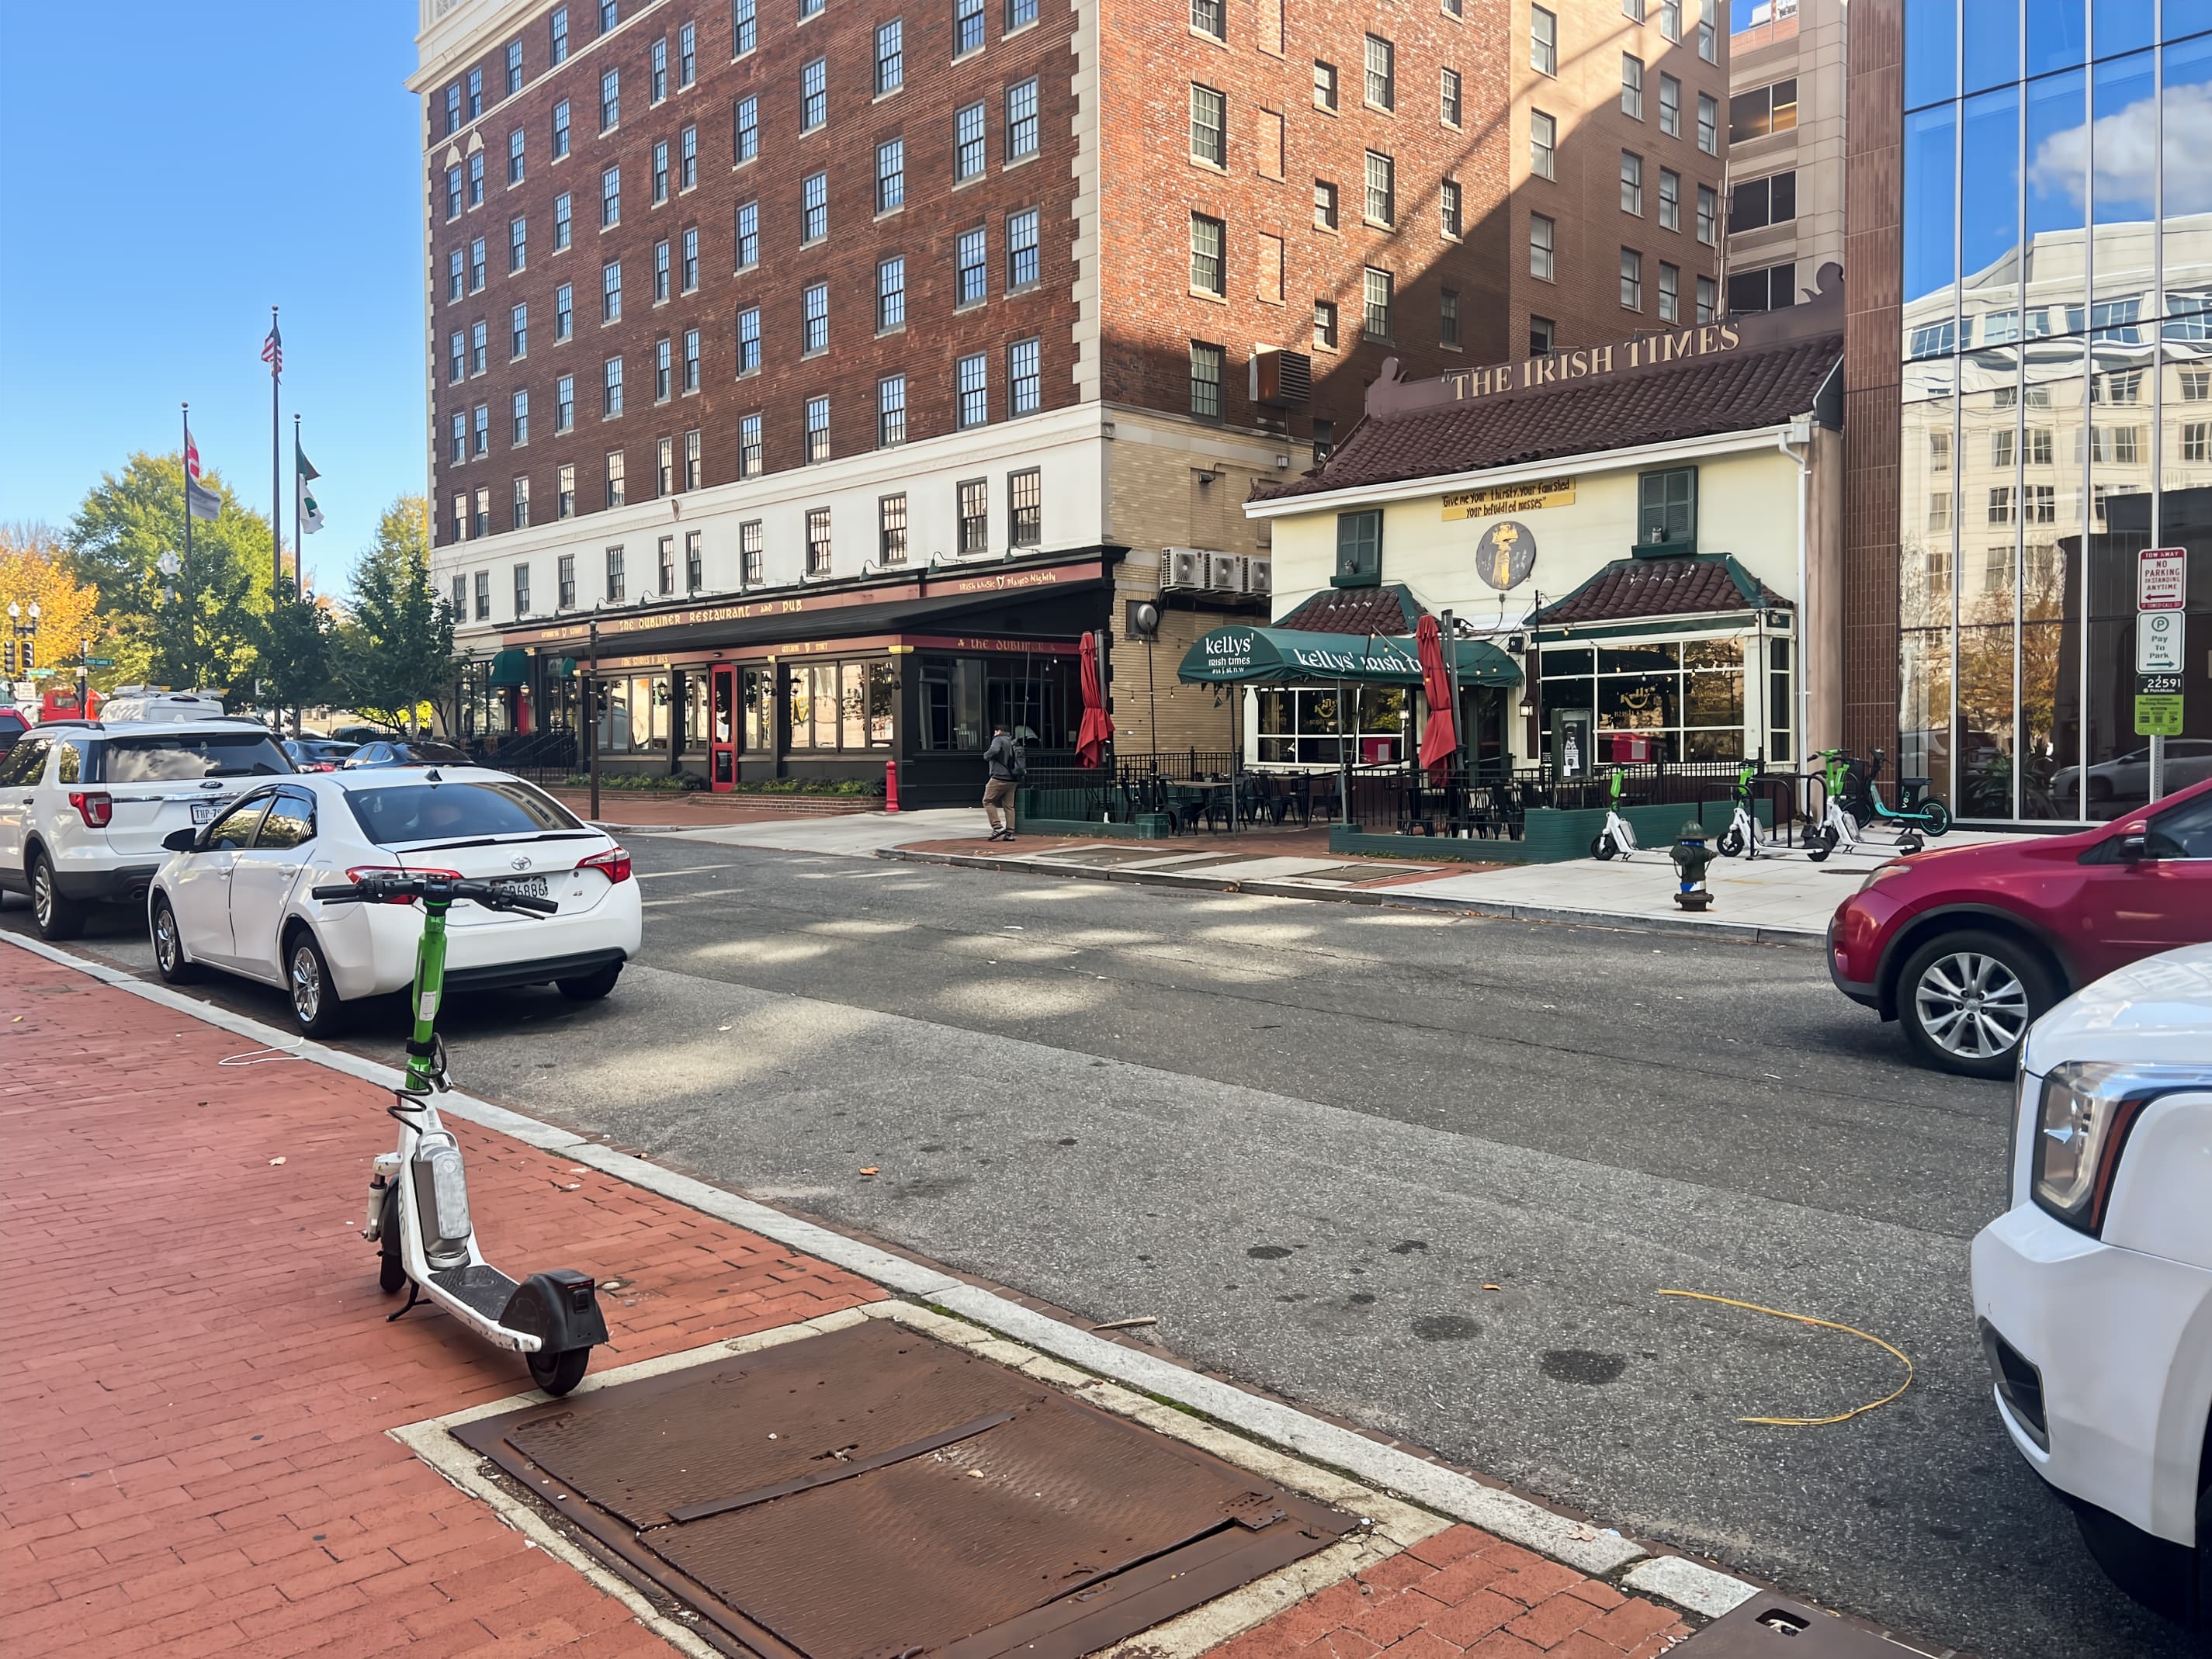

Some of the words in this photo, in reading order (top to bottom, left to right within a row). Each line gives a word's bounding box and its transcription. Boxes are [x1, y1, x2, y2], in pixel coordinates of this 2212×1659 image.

[1451, 365, 1513, 400] THE
[1522, 345, 1614, 387] IRISH
[1624, 323, 1740, 368] TIMES
[1470, 491, 1487, 504] your
[1466, 507, 1482, 519] your
[2156, 559, 2168, 568] NO
[2144, 568, 2180, 577] PARKING
[2148, 678, 2181, 688] 22591
